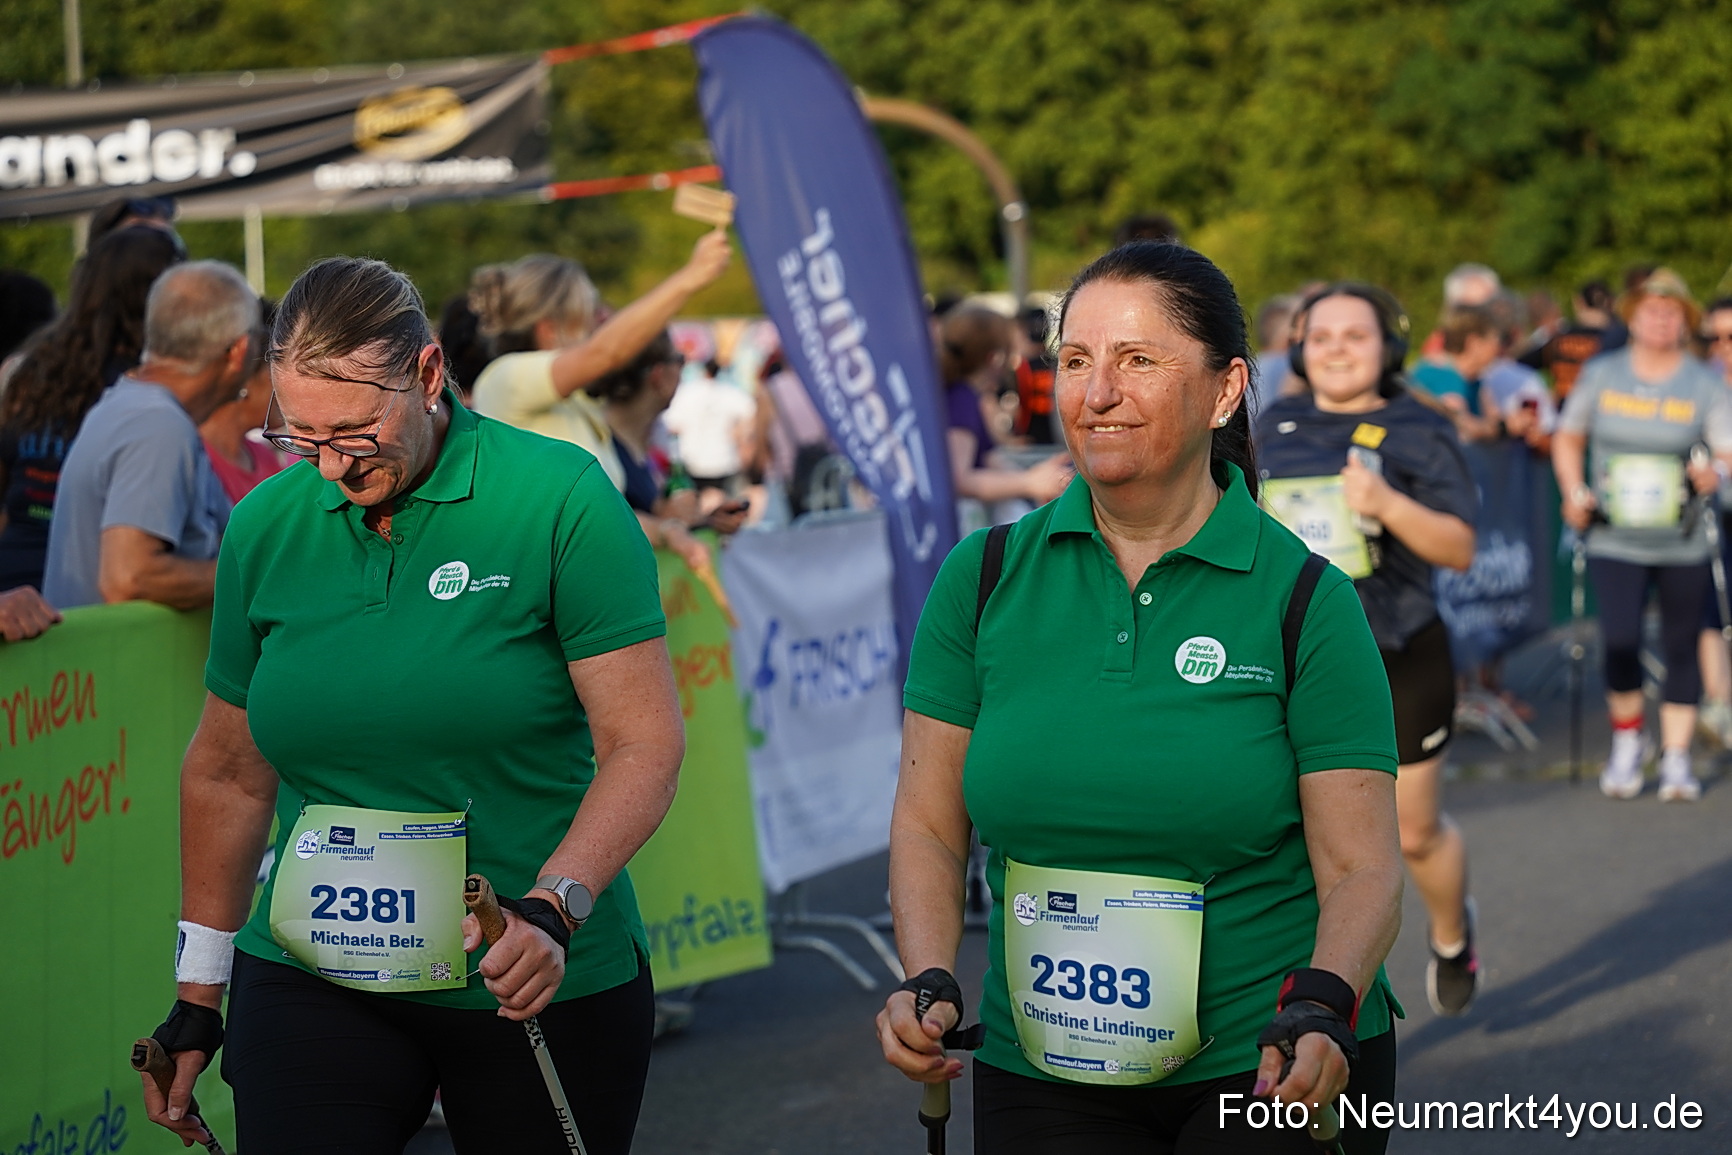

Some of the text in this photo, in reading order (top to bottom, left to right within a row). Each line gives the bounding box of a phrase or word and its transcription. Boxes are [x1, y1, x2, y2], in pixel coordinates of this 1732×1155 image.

[0, 117, 257, 189] ander.
[1187, 650, 1219, 660] Mensch
[0, 669, 98, 748] rmen
[2, 726, 133, 867] änger!
[319, 843, 375, 856] Firmenlauf
[340, 854, 375, 862] neumarkt
[310, 884, 416, 924] 2381
[1039, 911, 1100, 926] Firmenlauf
[1062, 923, 1099, 932] neumarkt
[310, 930, 425, 948] Michaela Belz
[320, 969, 376, 980] firmenlauf.bayern
[1030, 953, 1151, 1010] 2383
[1023, 1001, 1176, 1044] Christine Lindinger
[1068, 1033, 1118, 1046] RSG Eichenhof e.V.
[1046, 1055, 1102, 1071] firmenlauf.bayern
